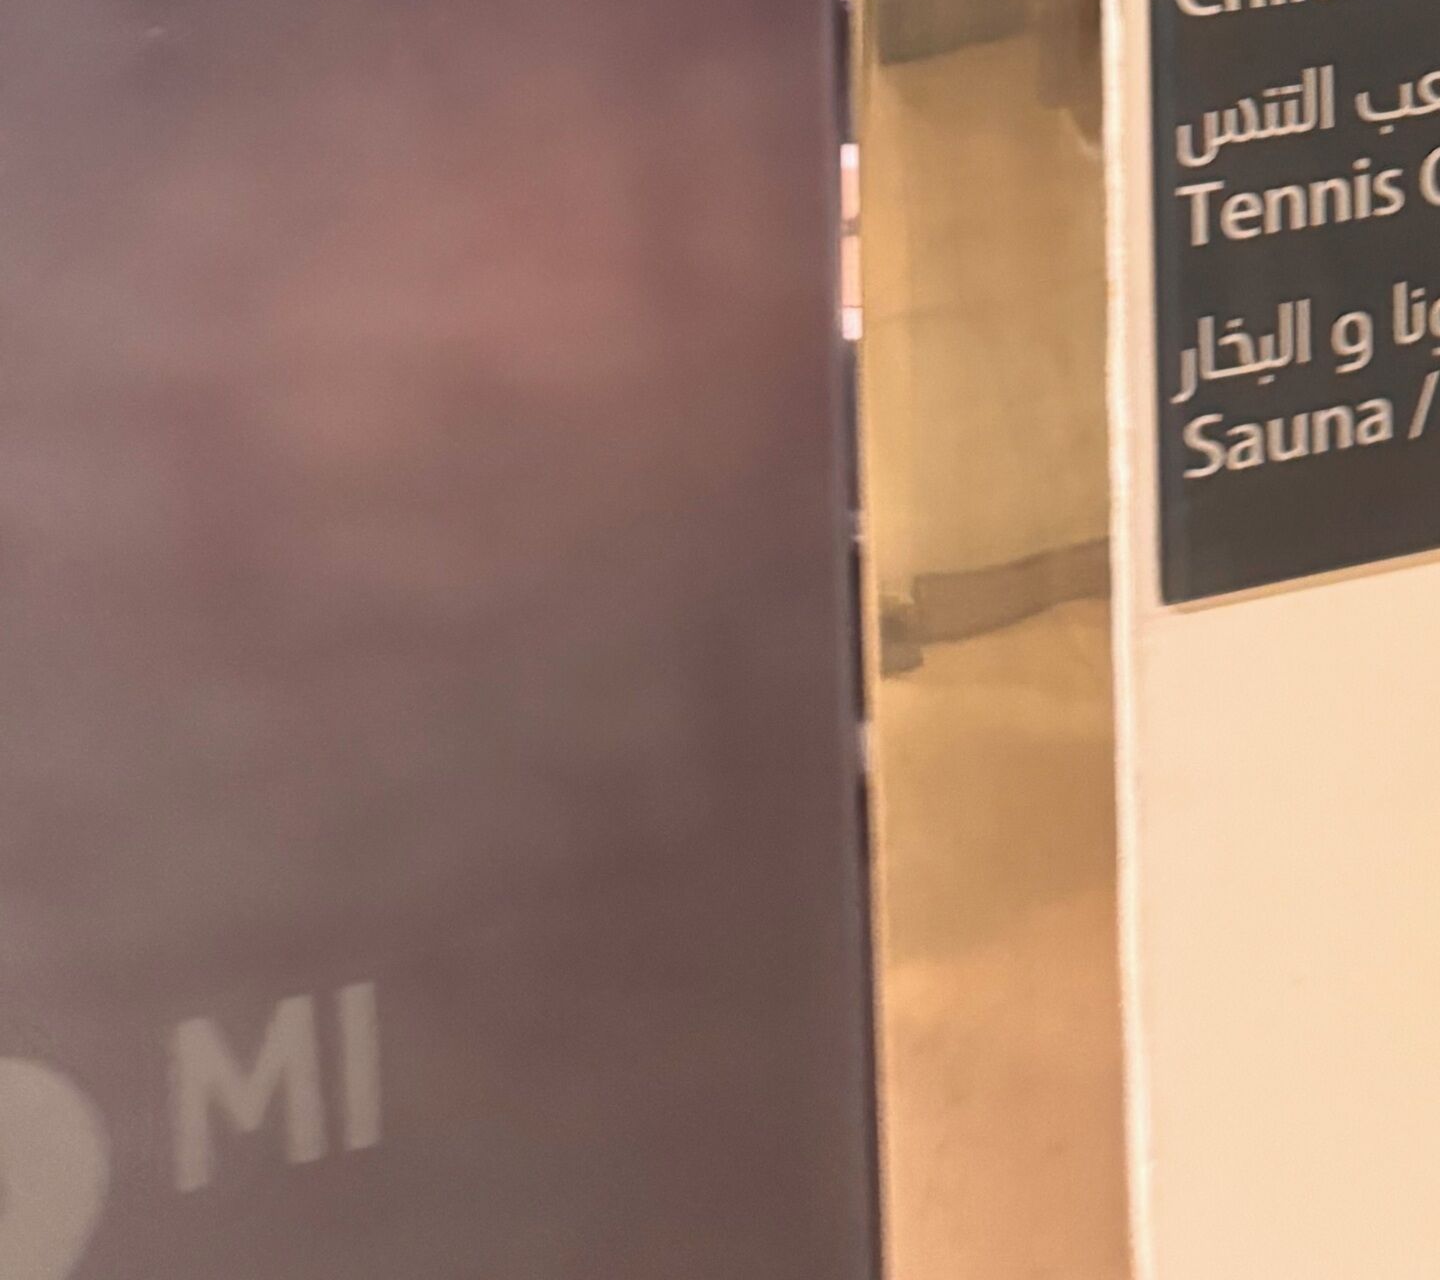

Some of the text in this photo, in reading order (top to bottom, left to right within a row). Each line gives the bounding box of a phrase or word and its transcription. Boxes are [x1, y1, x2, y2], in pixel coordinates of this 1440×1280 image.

[1175, 65, 1335, 168] التنس
[1175, 157, 1405, 247] Tennis
[1171, 298, 1311, 404] البخار
[1331, 311, 1374, 375] و
[1182, 397, 1394, 480] Sauna
[1407, 370, 1440, 440] /
